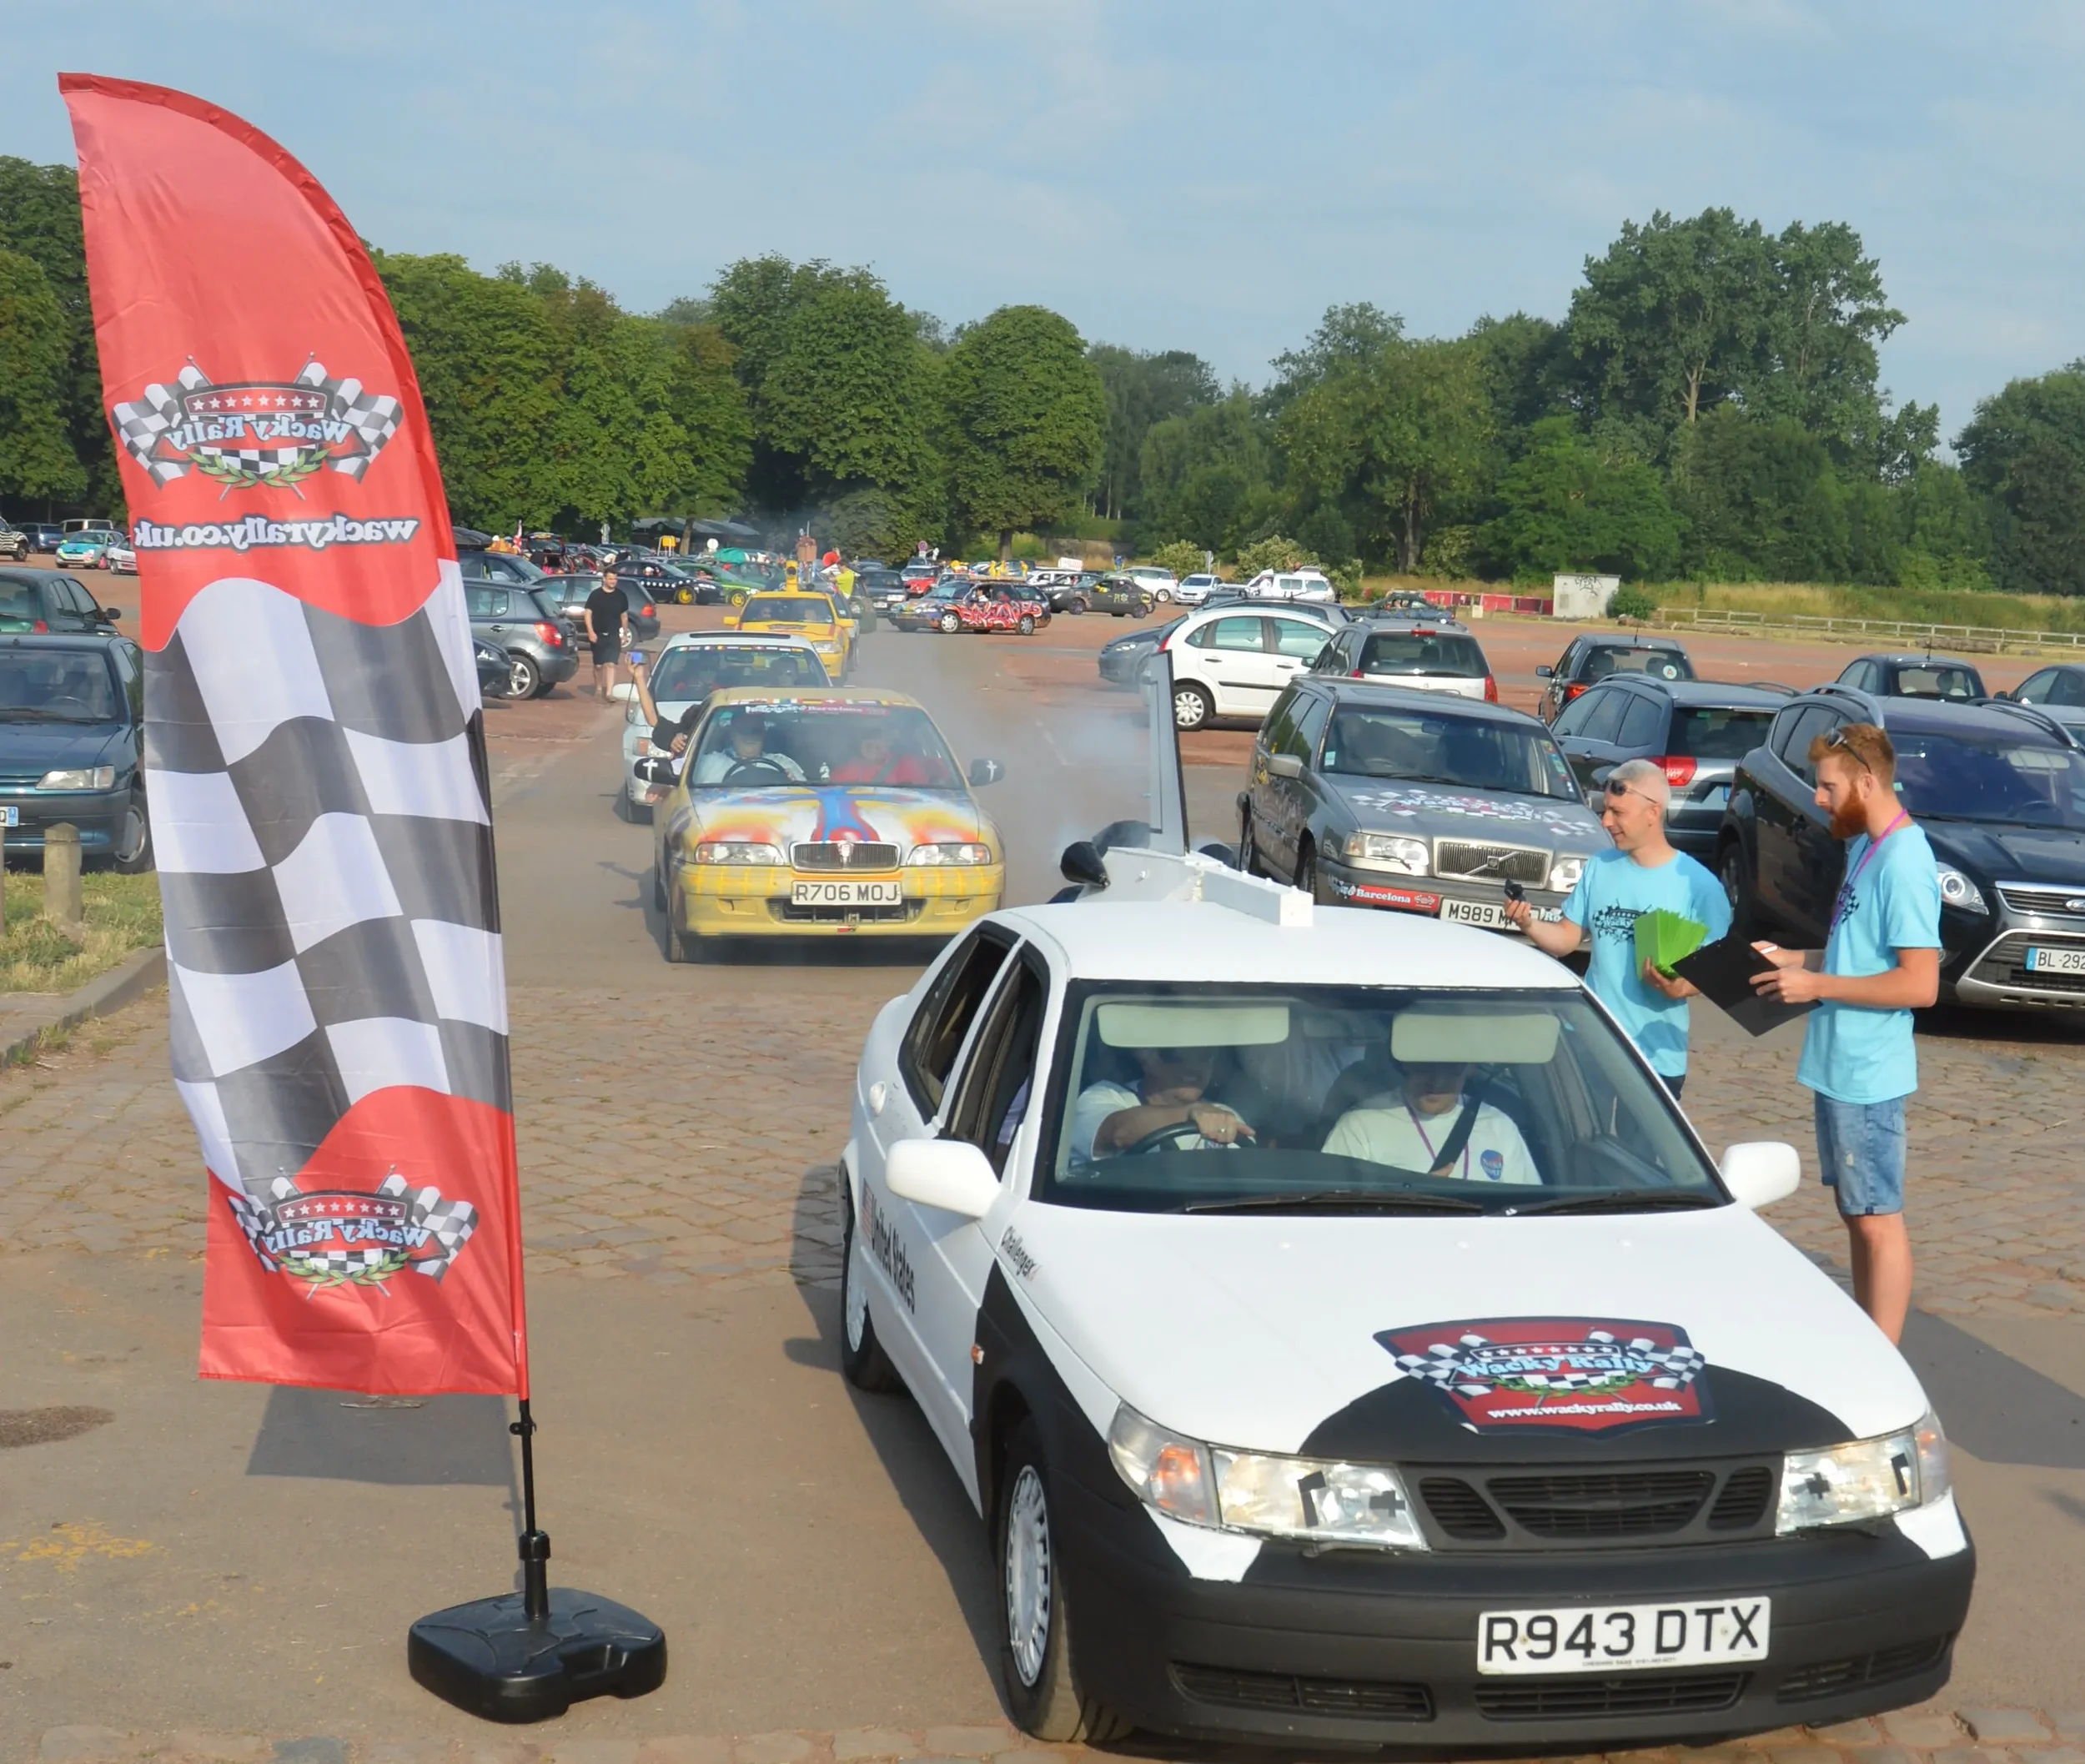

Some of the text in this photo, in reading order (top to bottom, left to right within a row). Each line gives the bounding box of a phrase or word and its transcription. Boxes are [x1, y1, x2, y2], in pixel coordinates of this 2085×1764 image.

[796, 884, 898, 902] R706 MOJ
[1356, 888, 1411, 904] Barcelona
[1448, 902, 1494, 923] M989
[871, 1194, 916, 1315] United States
[1001, 1225, 1037, 1277] Challenger
[1458, 1354, 1655, 1378] Wacky Rally
[1487, 1400, 1683, 1419] www.wackyrally.co.uk
[1485, 1604, 1761, 1662] R943 DTX
